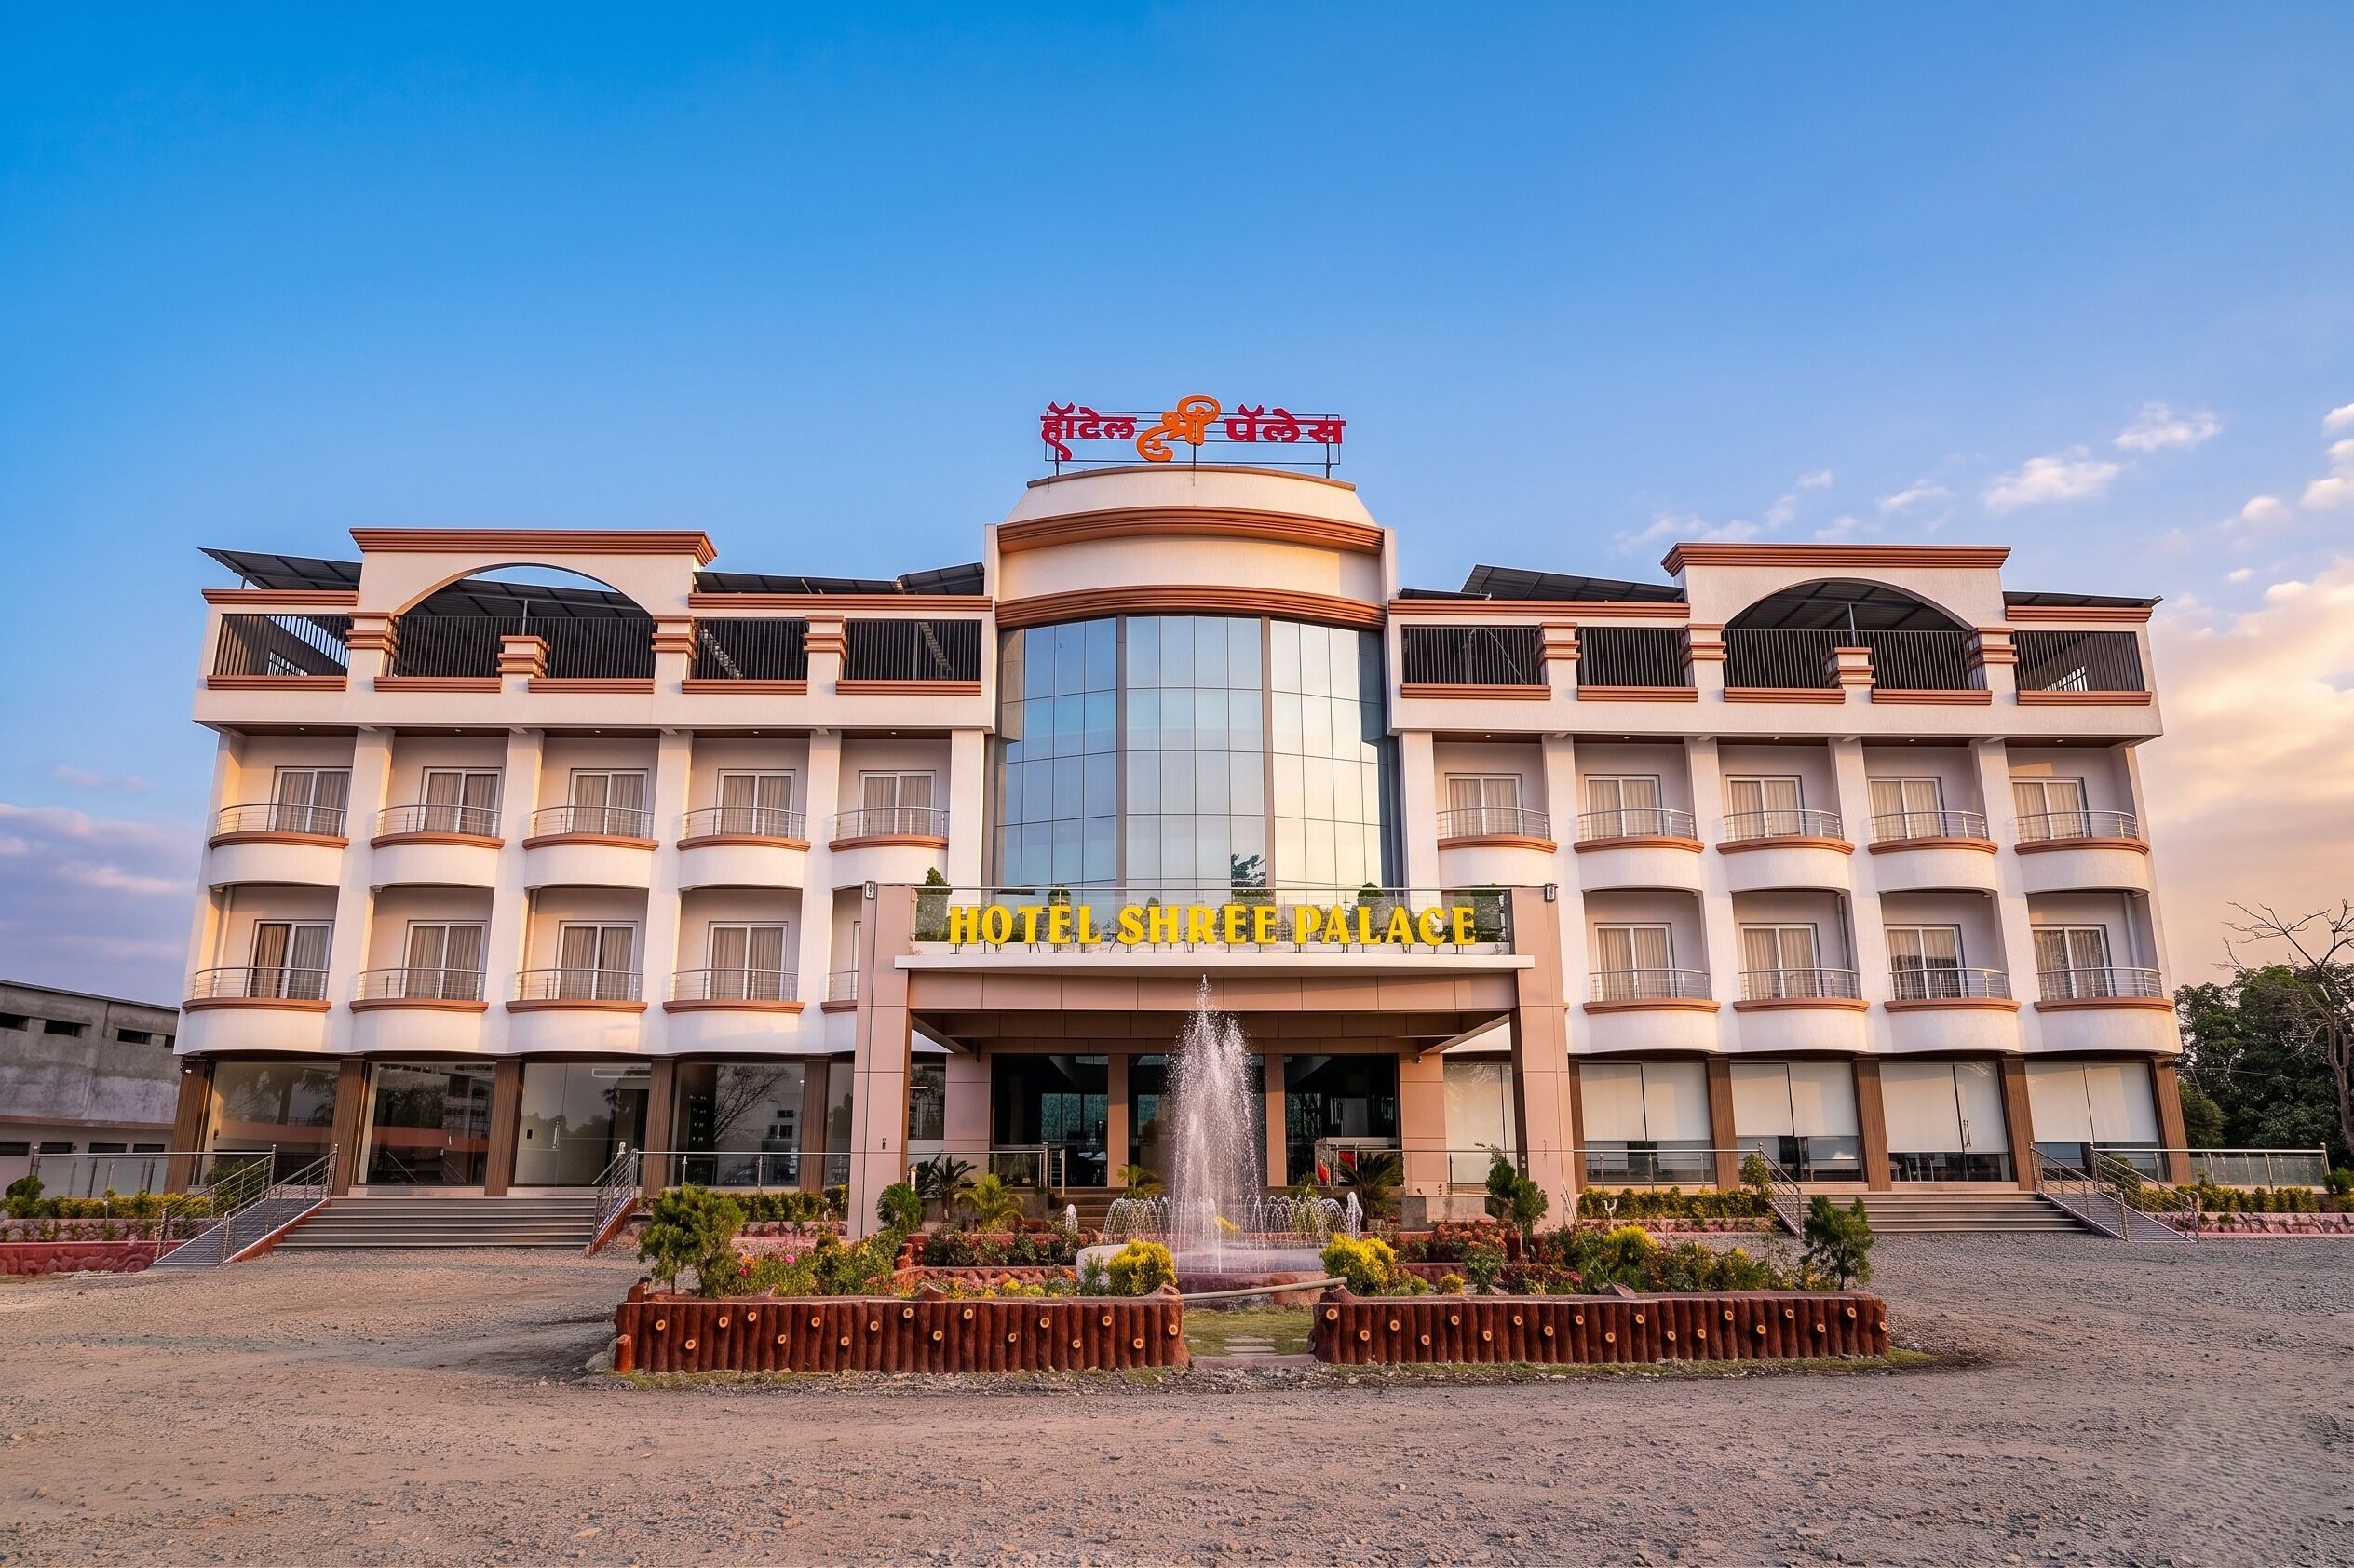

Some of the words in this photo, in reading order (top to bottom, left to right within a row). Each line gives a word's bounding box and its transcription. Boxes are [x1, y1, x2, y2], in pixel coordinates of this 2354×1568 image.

[1136, 394, 1222, 462] श्री
[949, 905, 1102, 945] HOTEL
[1117, 905, 1278, 945] SHREE
[1293, 905, 1476, 947] PALACE
